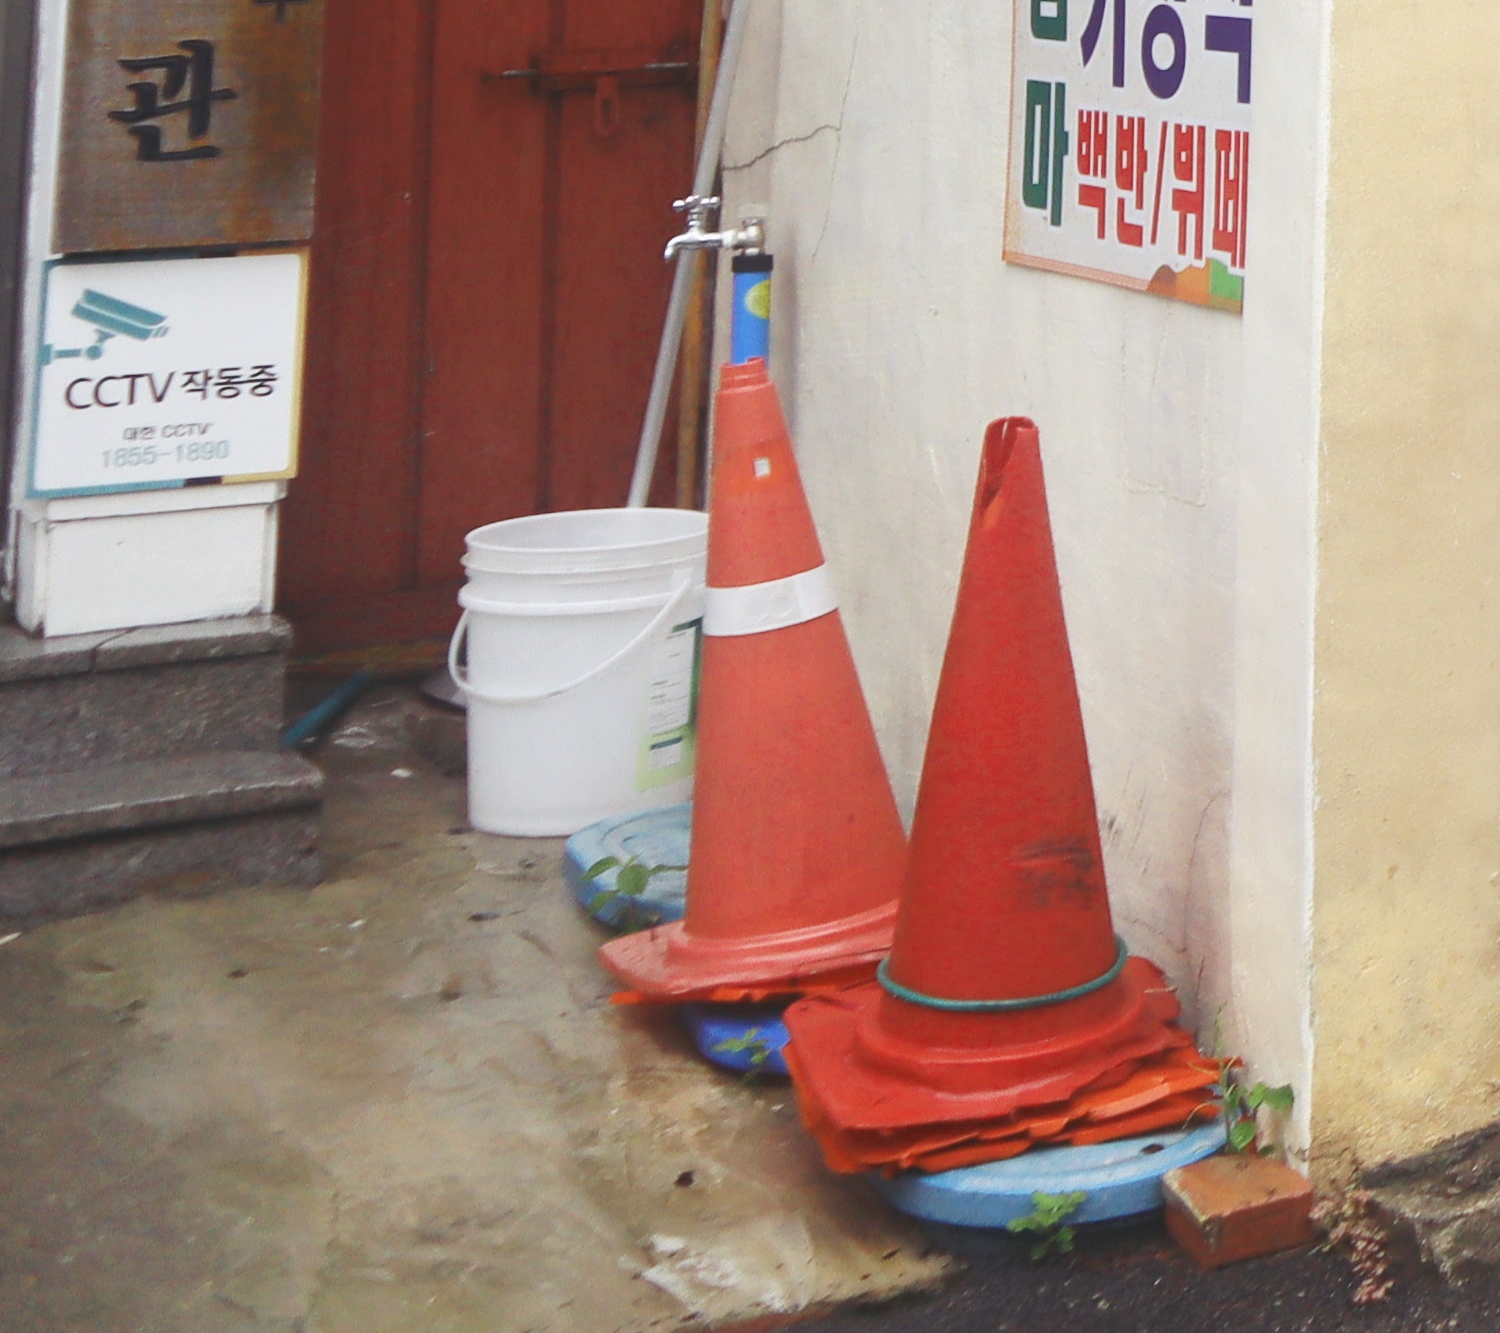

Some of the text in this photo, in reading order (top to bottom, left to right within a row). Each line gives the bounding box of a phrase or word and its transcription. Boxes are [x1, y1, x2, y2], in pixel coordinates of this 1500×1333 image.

[1076, 109, 1249, 269] 백반/뷔페
[65, 364, 278, 410] CCTV 작동중
[100, 440, 231, 469] 1855-1890
